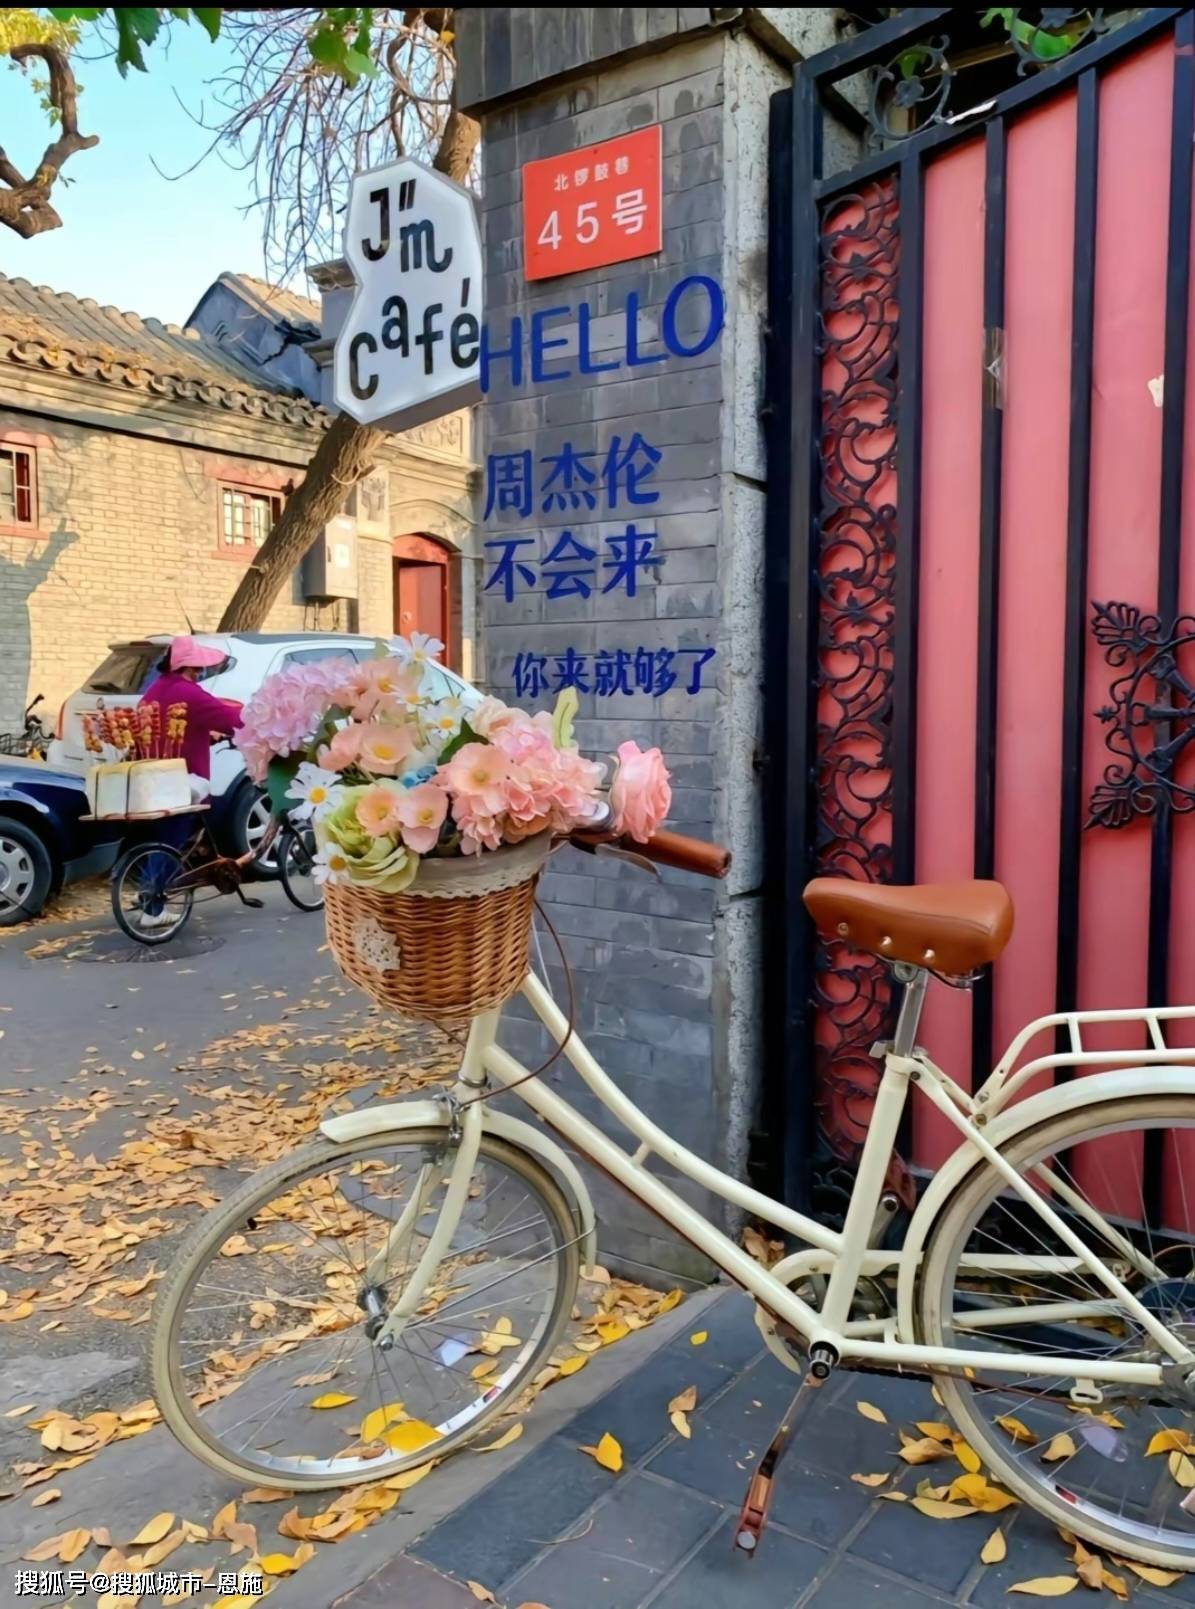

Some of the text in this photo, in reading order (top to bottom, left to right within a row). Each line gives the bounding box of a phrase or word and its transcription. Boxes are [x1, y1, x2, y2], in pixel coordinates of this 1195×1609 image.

[537, 188, 648, 250] 45号
[480, 275, 725, 394] HELLO
[484, 432, 663, 522] 周杰伦
[484, 524, 665, 603] 不会来
[511, 646, 716, 698] 你来就够了
